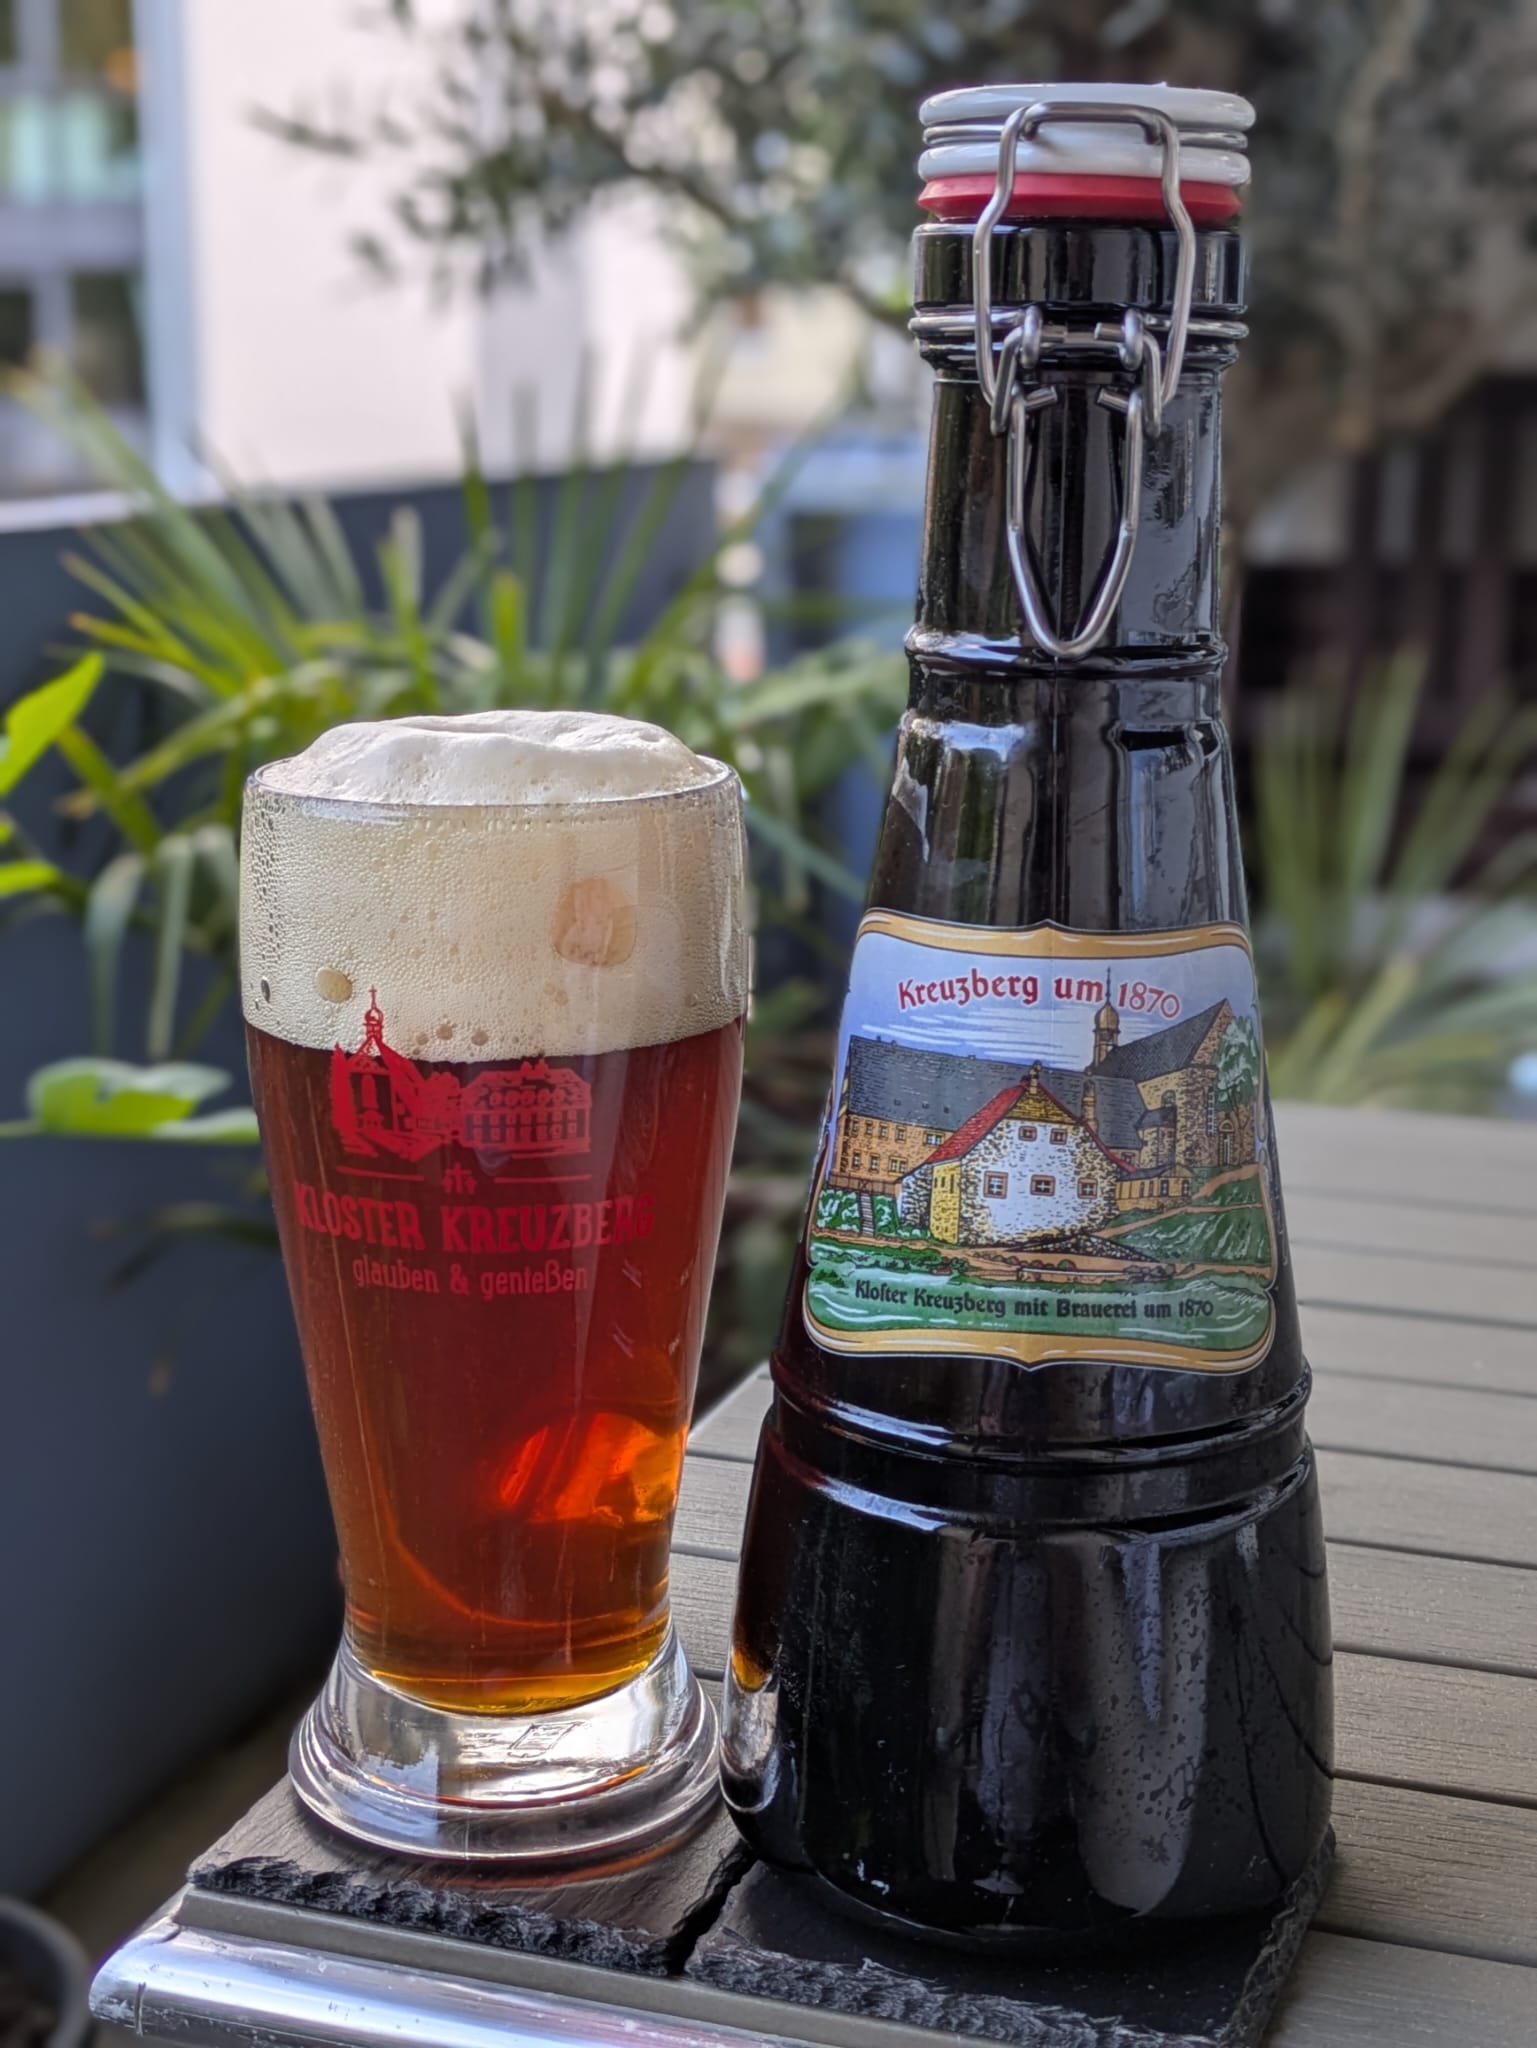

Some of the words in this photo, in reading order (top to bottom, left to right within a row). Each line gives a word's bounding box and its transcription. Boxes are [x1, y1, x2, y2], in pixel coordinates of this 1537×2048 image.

[898, 967, 1039, 1010] Kreuzberg
[1054, 976, 1103, 1003] um
[1118, 982, 1181, 1018] 1870
[293, 1181, 425, 1249] KLOSTER
[441, 1196, 657, 1253] KREUZBERG
[352, 1254, 439, 1293] glauben
[449, 1264, 469, 1295] &
[480, 1259, 588, 1300] genießen
[913, 1288, 1006, 1317] Kreuzberg
[1014, 1298, 1048, 1316] mit
[1056, 1299, 1137, 1318] Brauerei
[1143, 1301, 1171, 1318] um
[1179, 1299, 1214, 1317] 1870
